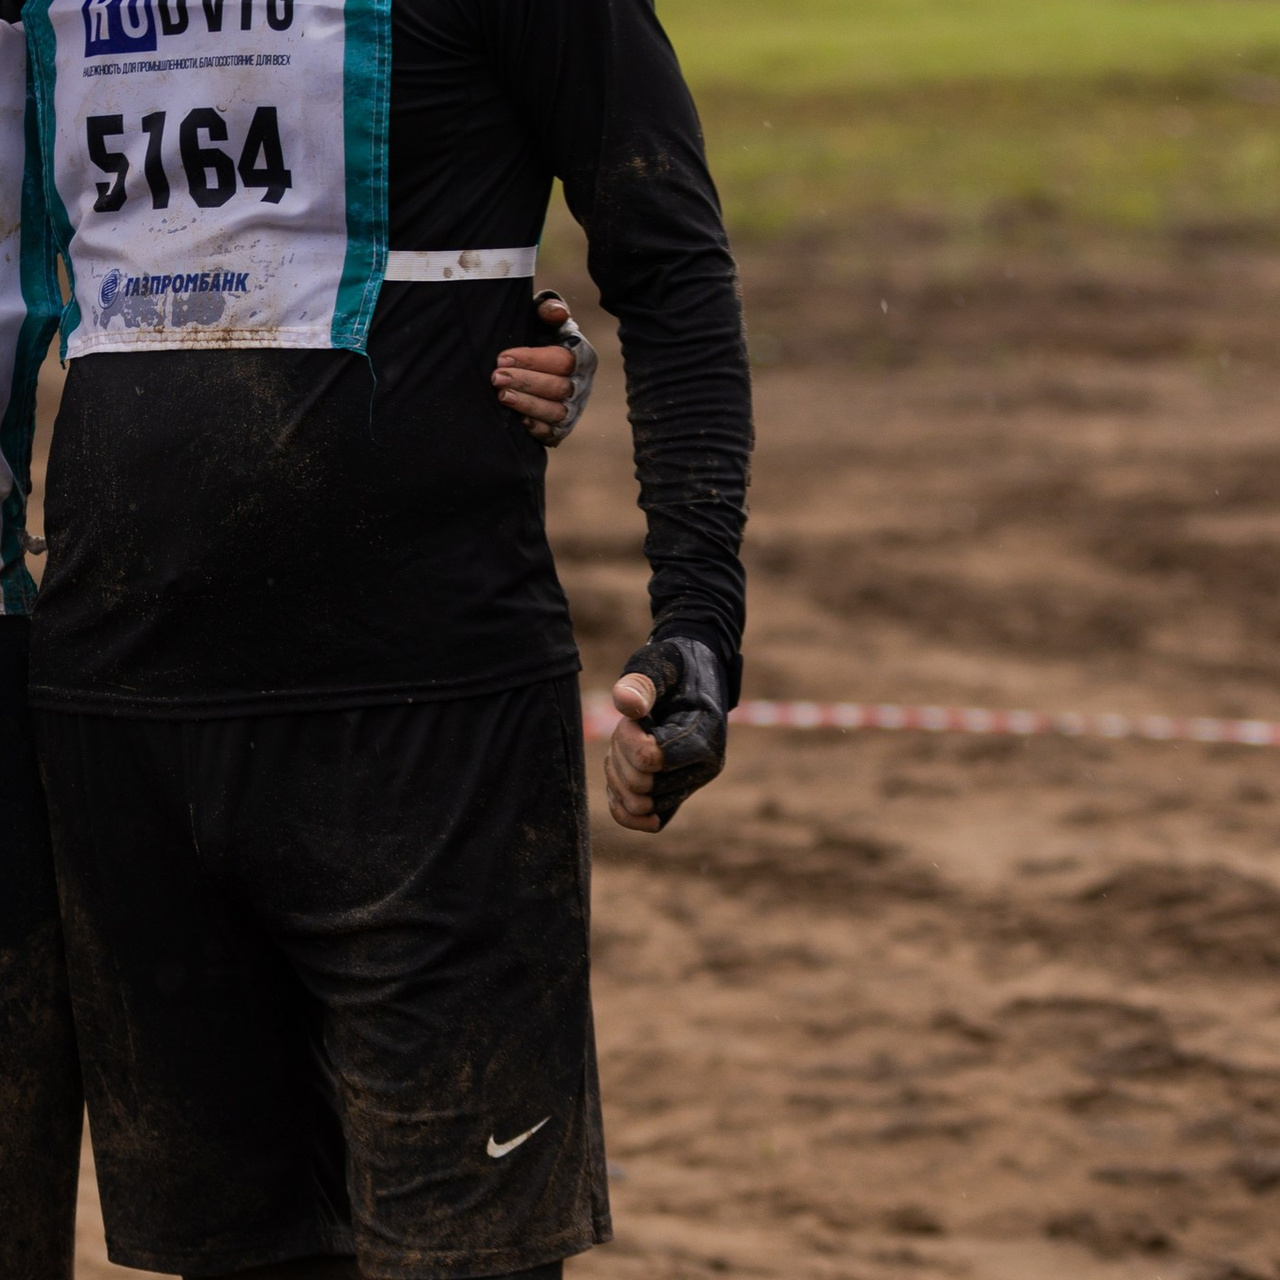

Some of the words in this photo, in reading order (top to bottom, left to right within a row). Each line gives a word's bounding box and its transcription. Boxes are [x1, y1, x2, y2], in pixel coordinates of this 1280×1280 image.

[122, 62, 137, 74] ДЛЯ
[199, 55, 255, 69] БЛАГОСОСТОЯНИЕ
[255, 54, 272, 66] ДЛЯ
[272, 54, 291, 66] ВСЕХ
[87, 106, 292, 213] 5164
[125, 273, 249, 296] ГАЗПРОМБАНК
